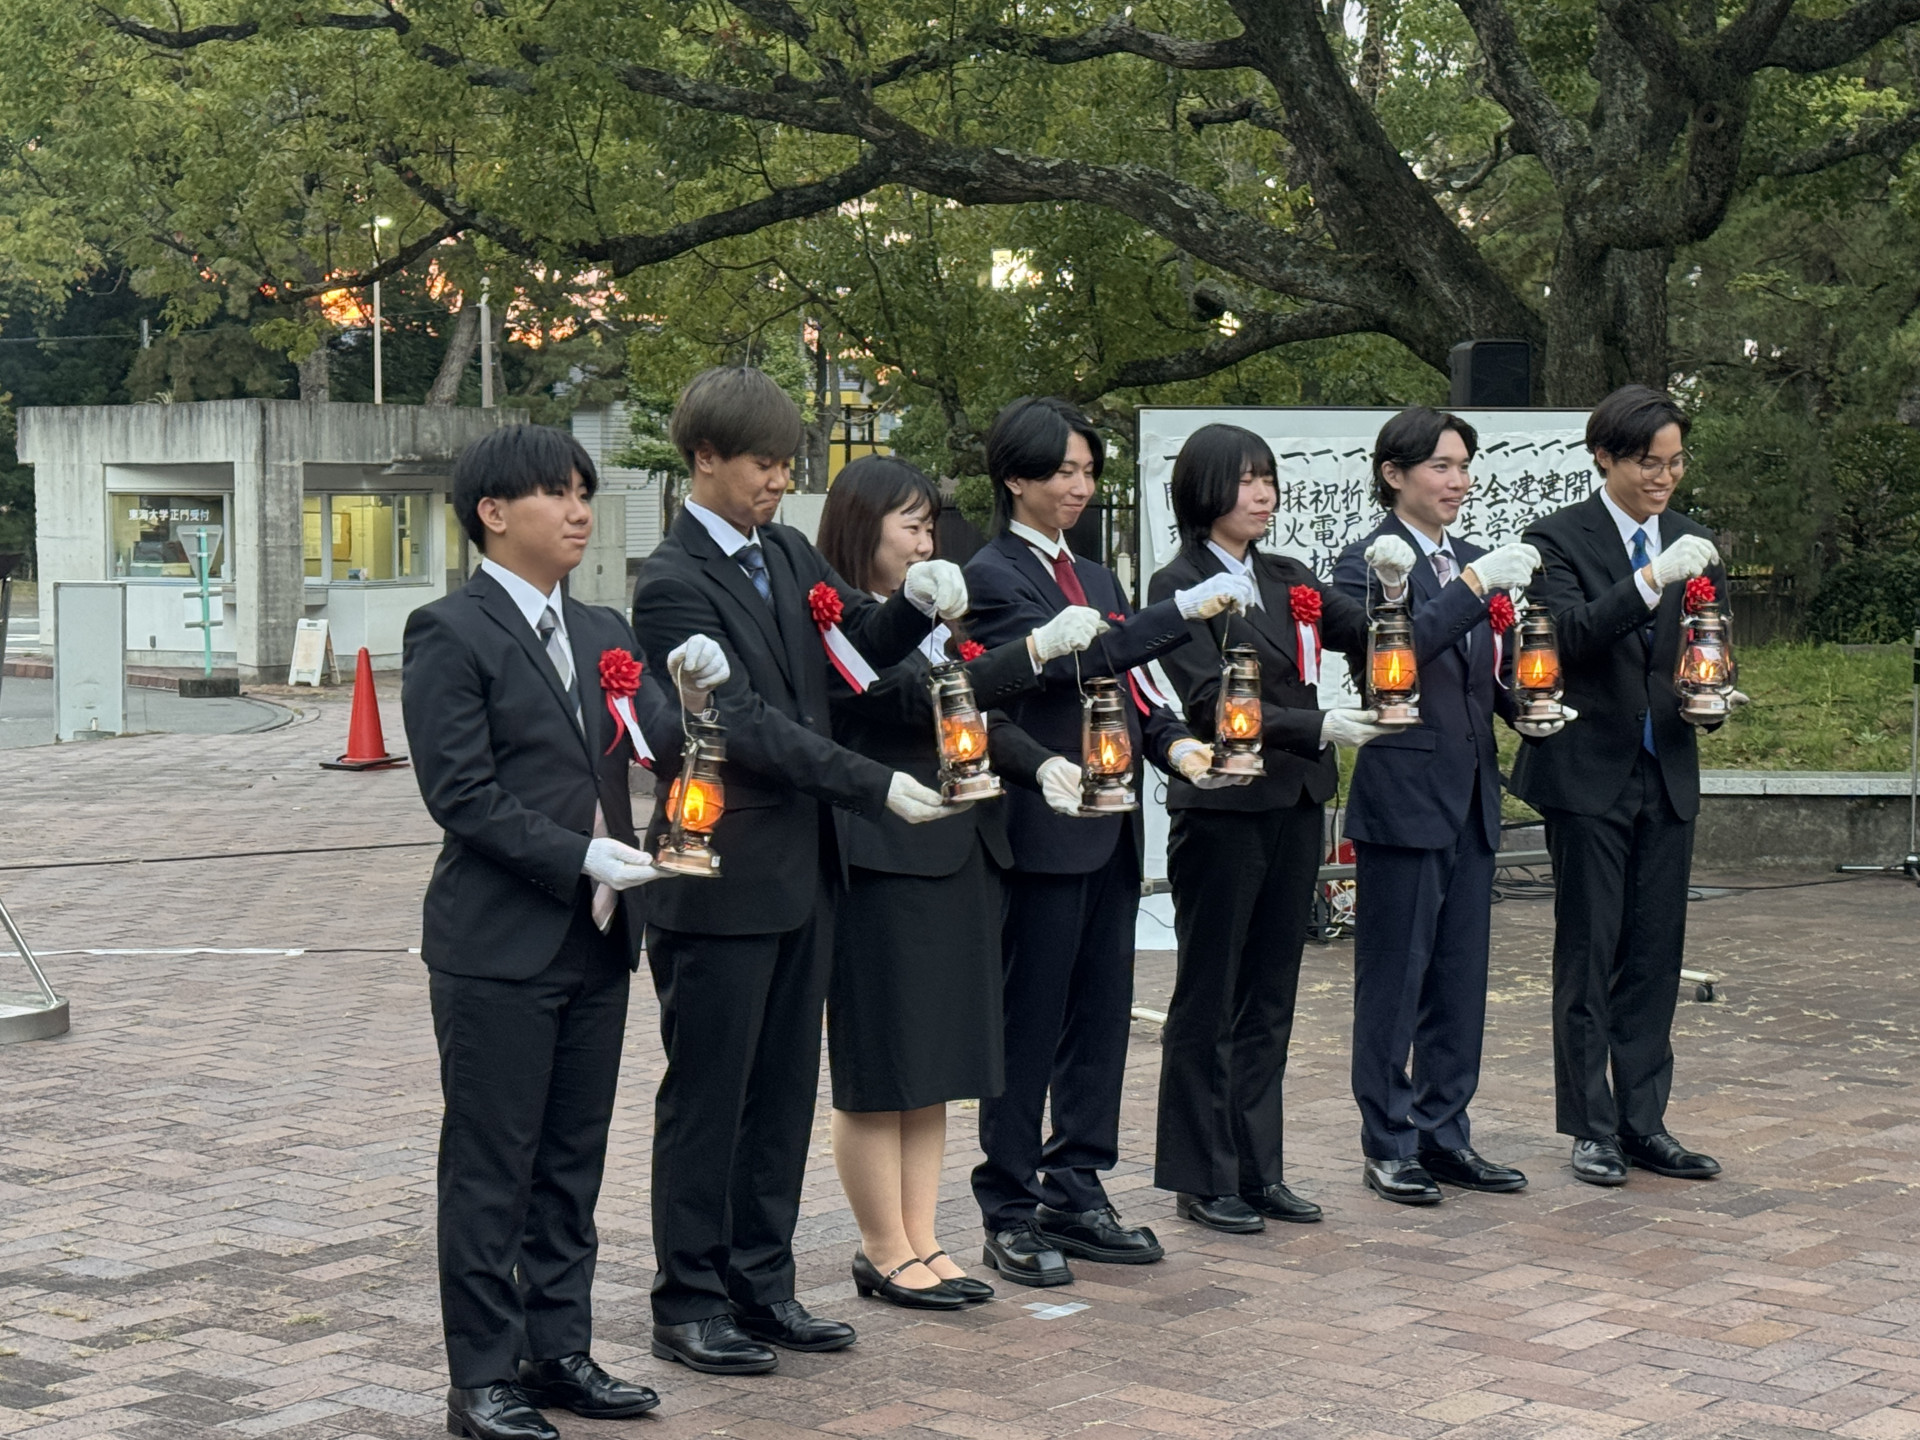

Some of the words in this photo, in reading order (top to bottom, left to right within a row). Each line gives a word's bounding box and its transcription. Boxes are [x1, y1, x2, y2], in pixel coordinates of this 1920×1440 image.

[128, 508, 210, 521] 東海大学正門受付
[1340, 447, 1366, 549] 一、折戸
[1481, 440, 1511, 552] 一、全学
